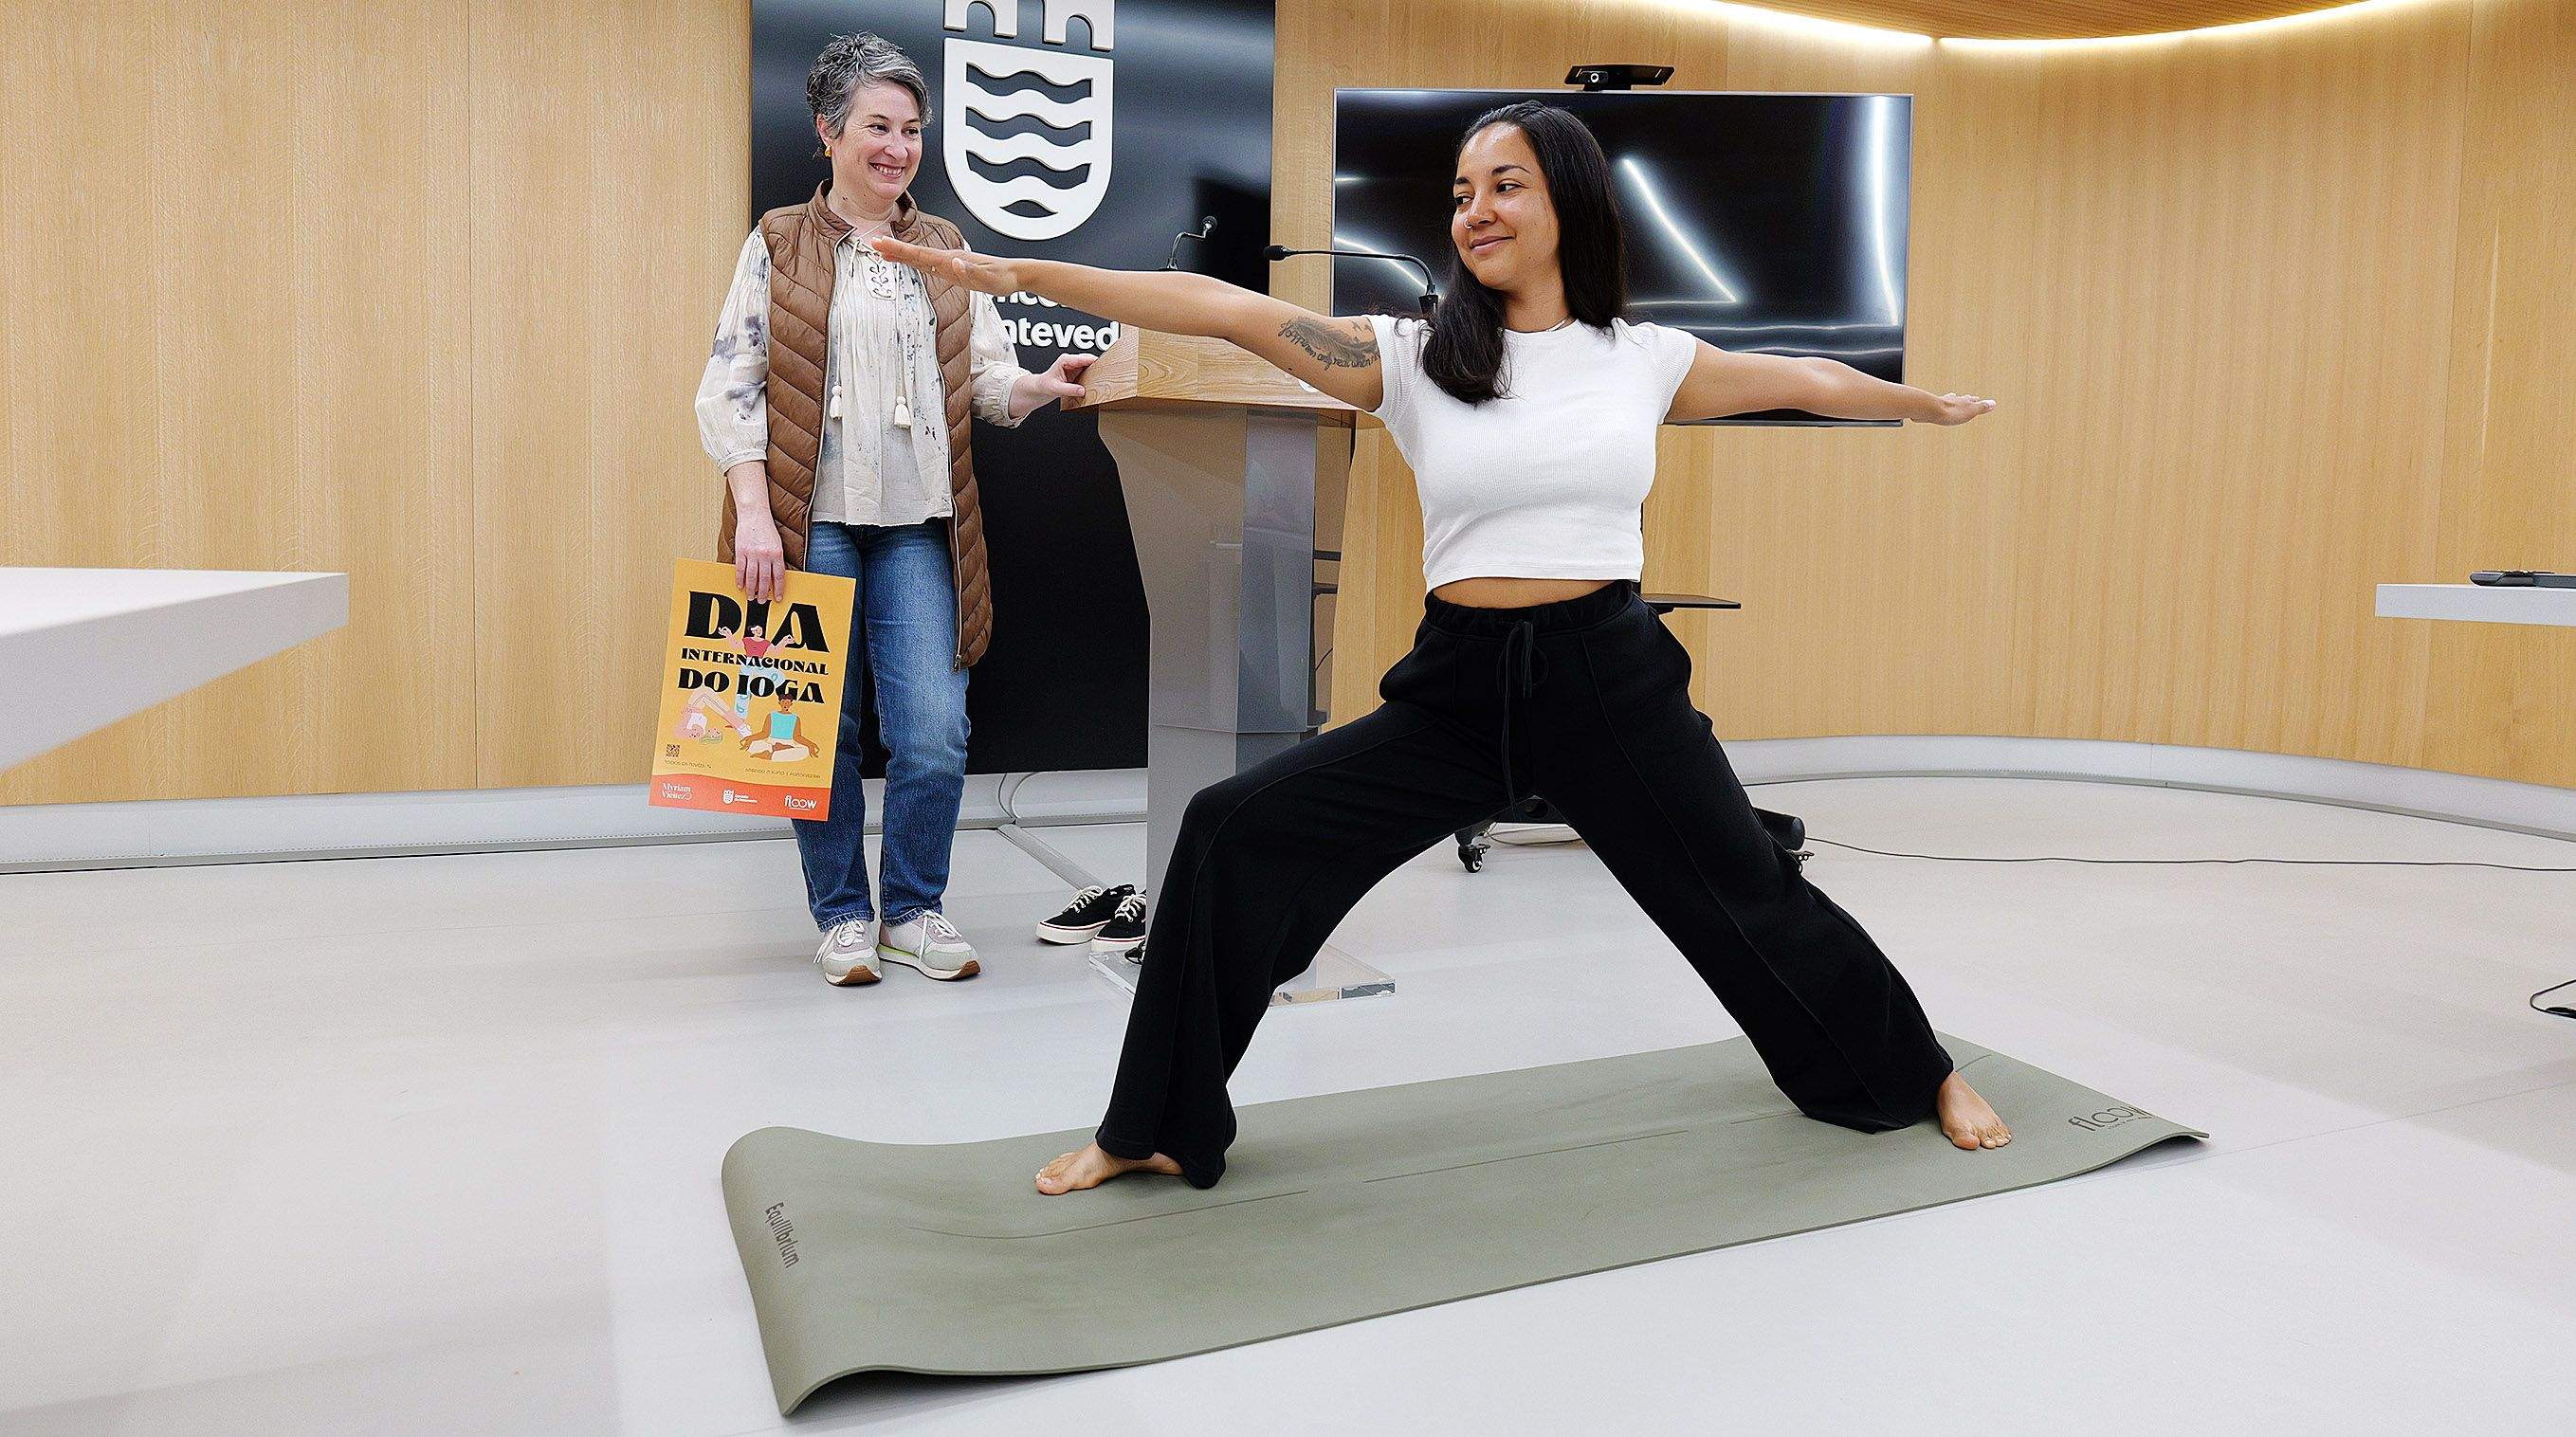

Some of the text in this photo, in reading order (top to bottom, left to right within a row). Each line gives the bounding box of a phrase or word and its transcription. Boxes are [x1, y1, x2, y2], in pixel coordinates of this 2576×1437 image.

[1000, 317, 1121, 352] nteved
[681, 647, 830, 675] INTERNACIONAL
[677, 667, 825, 703] DO IOGA
[765, 1202, 799, 1268] Equilibrium
